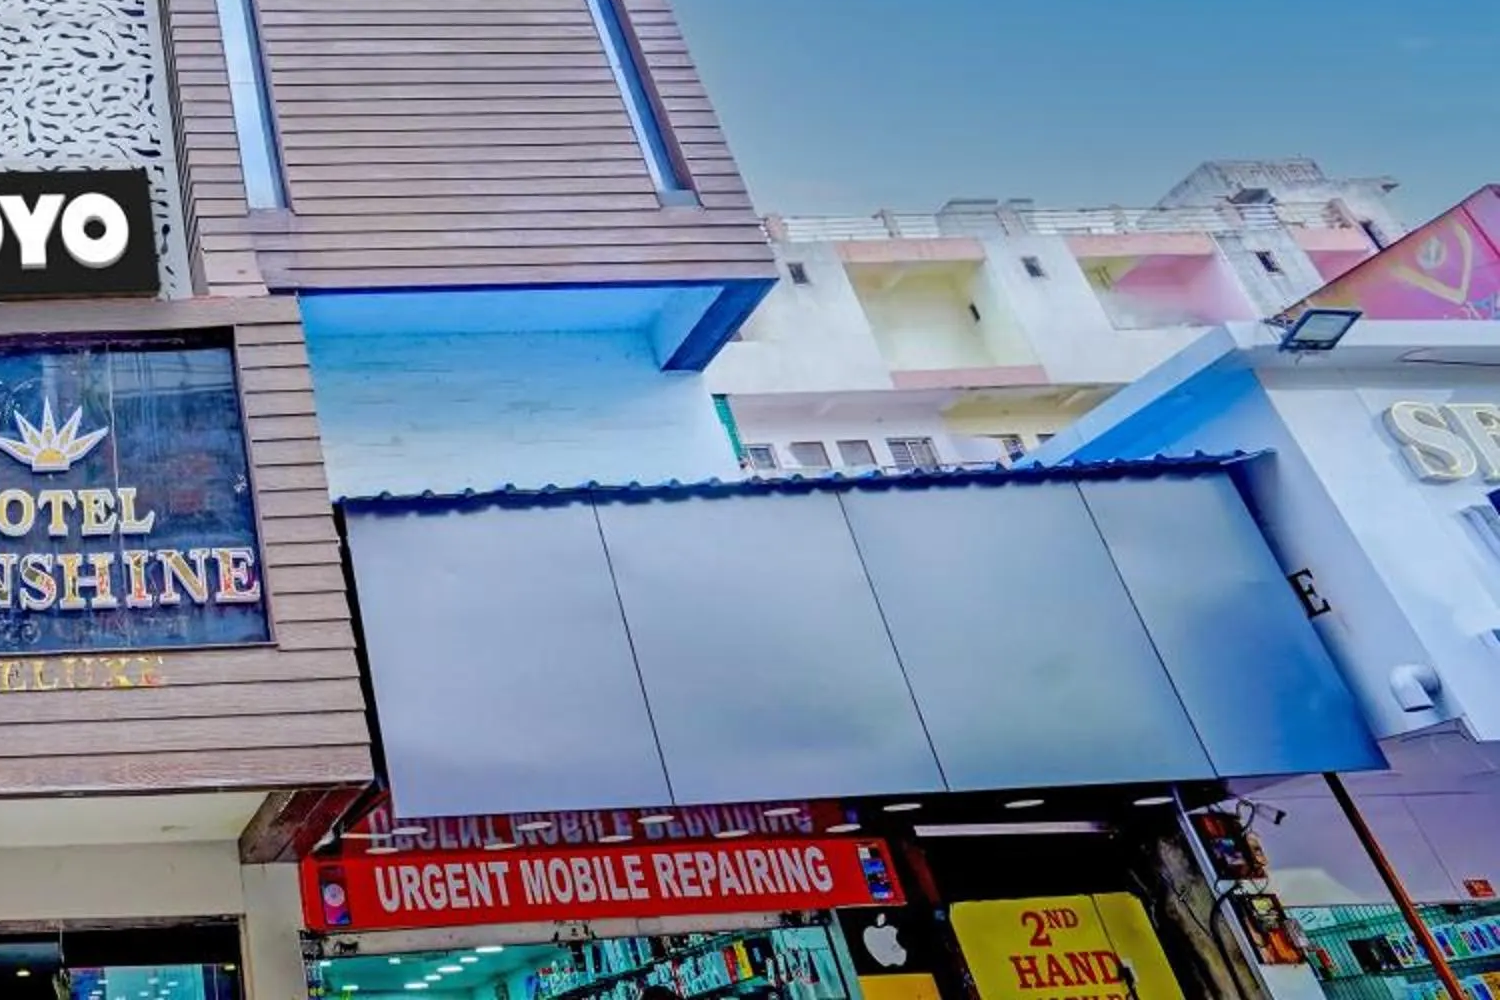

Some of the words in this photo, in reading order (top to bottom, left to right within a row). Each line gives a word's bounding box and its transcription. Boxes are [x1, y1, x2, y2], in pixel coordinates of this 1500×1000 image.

[375, 861, 510, 912] URGENT
[519, 854, 650, 905] MOBILE
[652, 846, 834, 899] REPAIRING
[1009, 950, 1124, 989] HAND
